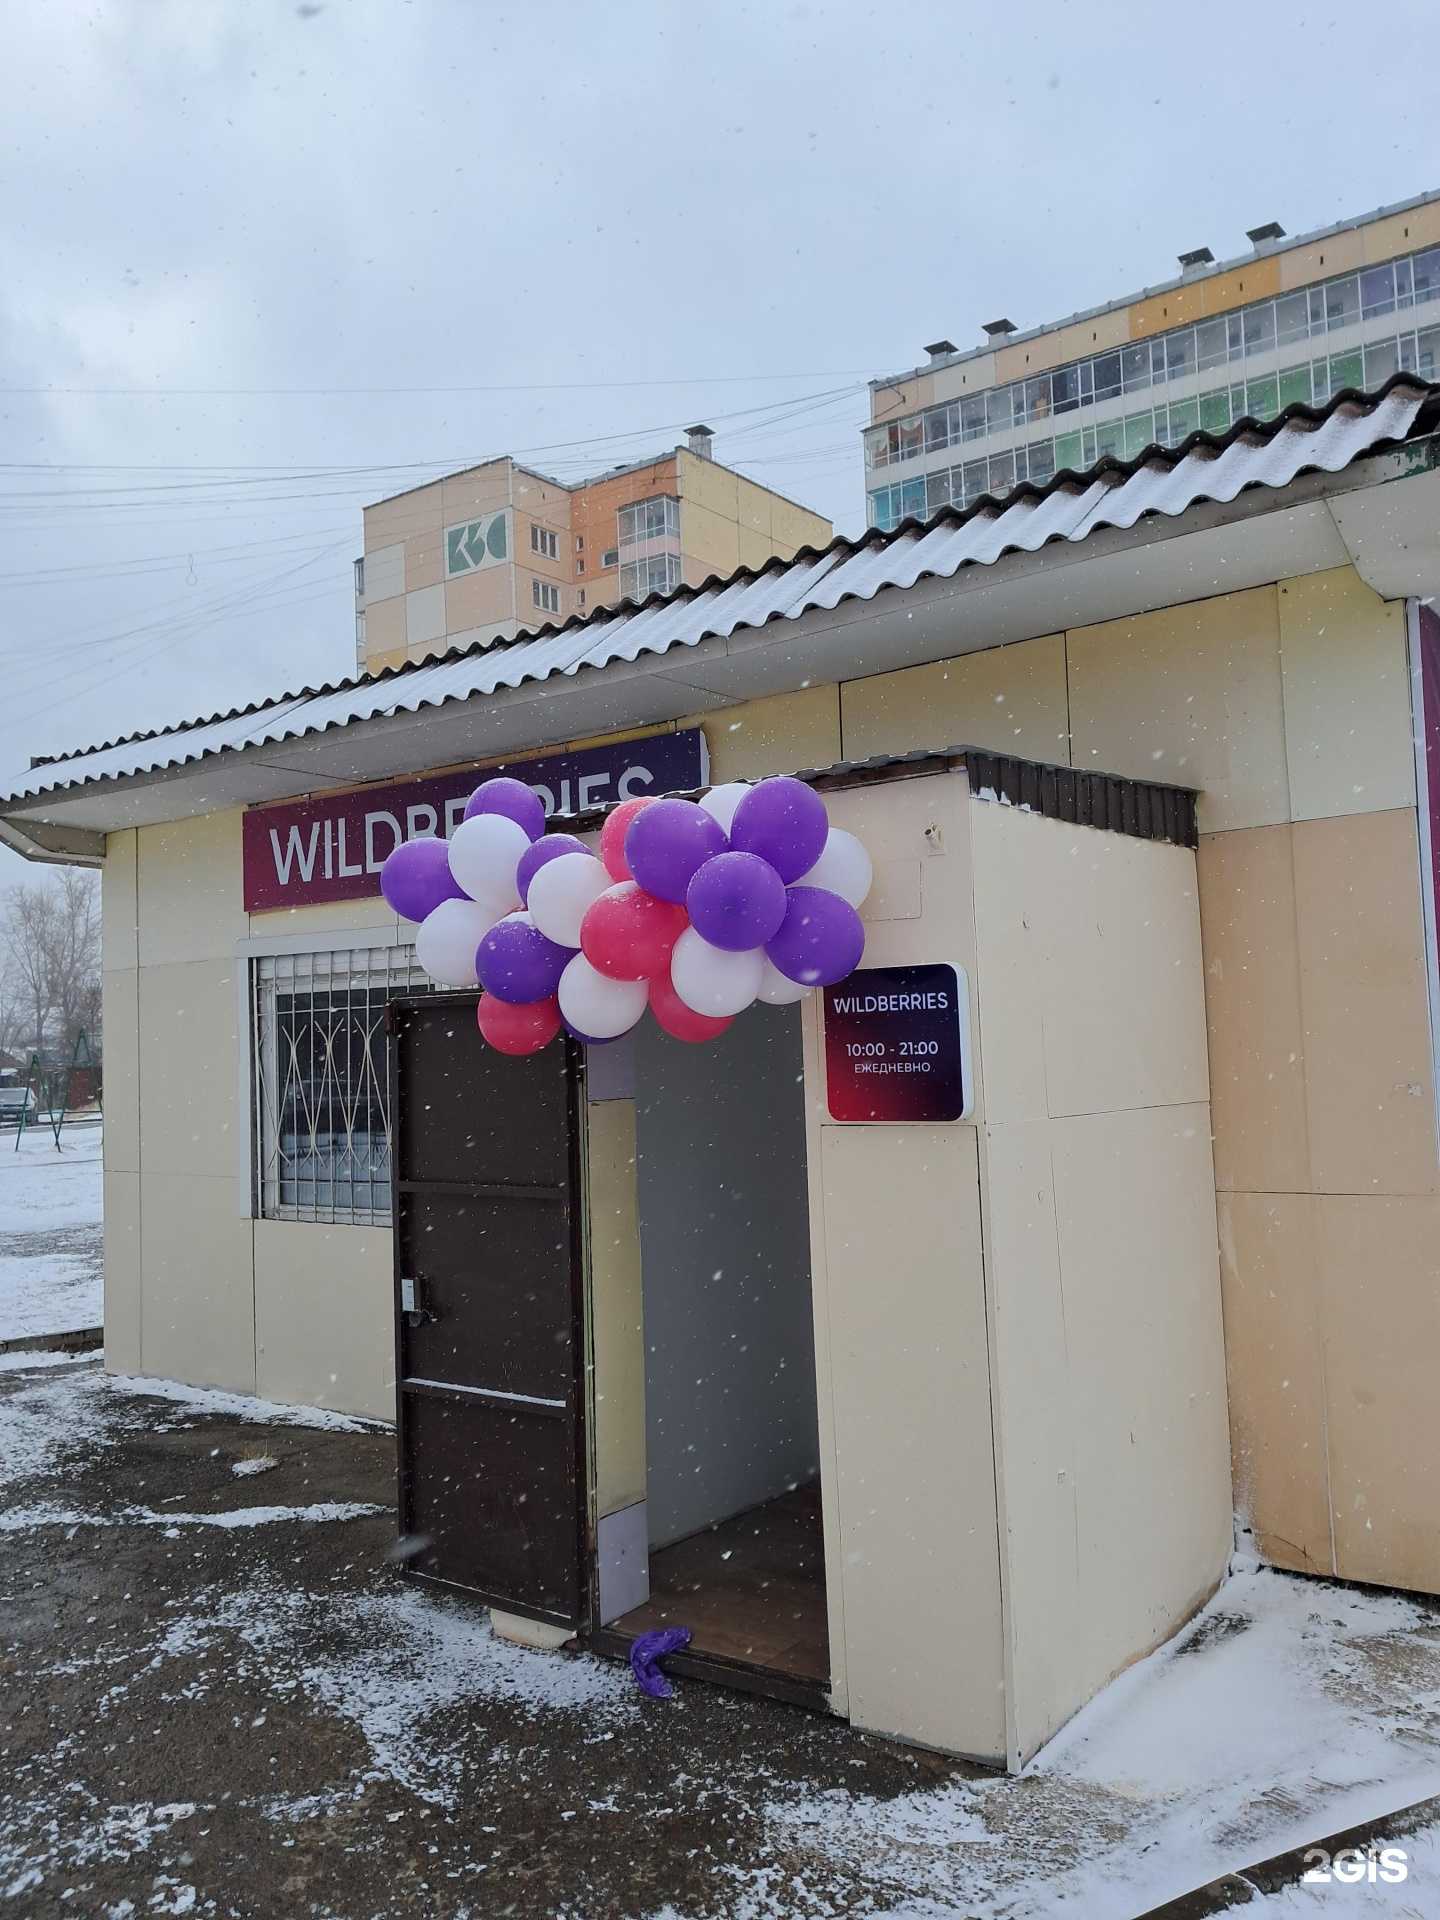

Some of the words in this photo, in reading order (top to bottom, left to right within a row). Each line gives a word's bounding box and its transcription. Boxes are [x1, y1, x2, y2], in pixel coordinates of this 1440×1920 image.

[269, 766, 655, 885] WILDBEIES
[833, 992, 949, 1013] WILDBERRIES
[846, 1042, 885, 1057] 10:00
[899, 1041, 939, 1056] 21:00
[854, 1062, 931, 1075] ЕЖЕДНЕВНО
